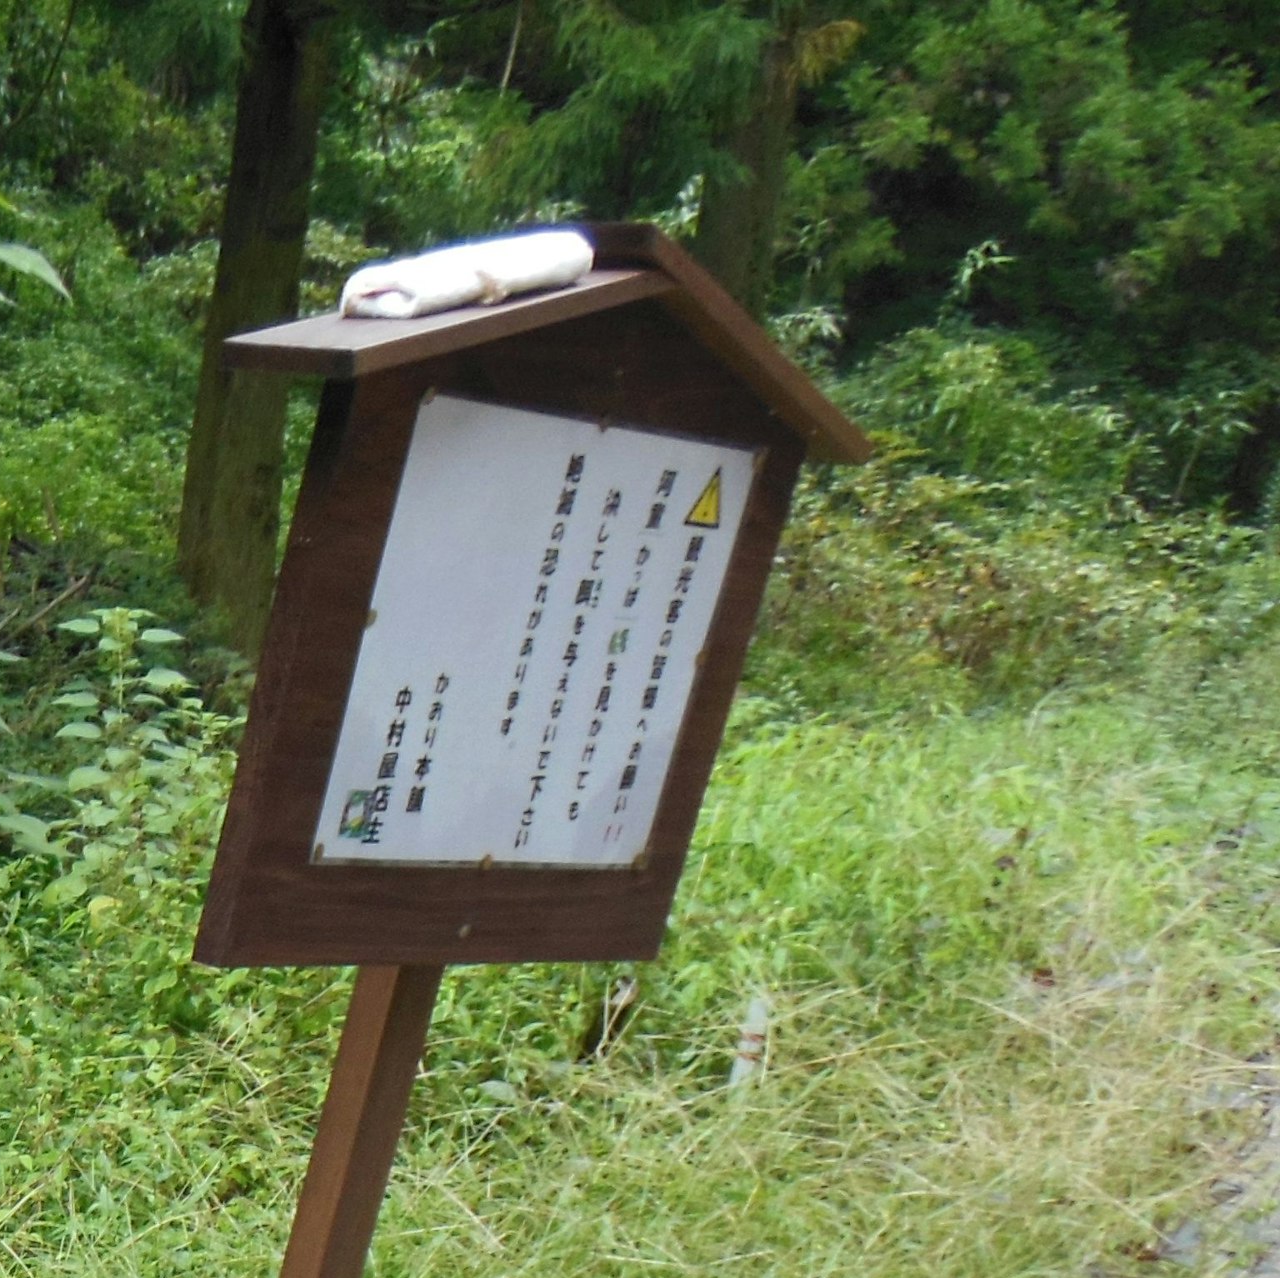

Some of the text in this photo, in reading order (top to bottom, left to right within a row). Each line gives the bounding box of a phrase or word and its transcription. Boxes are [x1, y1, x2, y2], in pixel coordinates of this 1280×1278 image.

[361, 687, 412, 843] 中村屋店主
